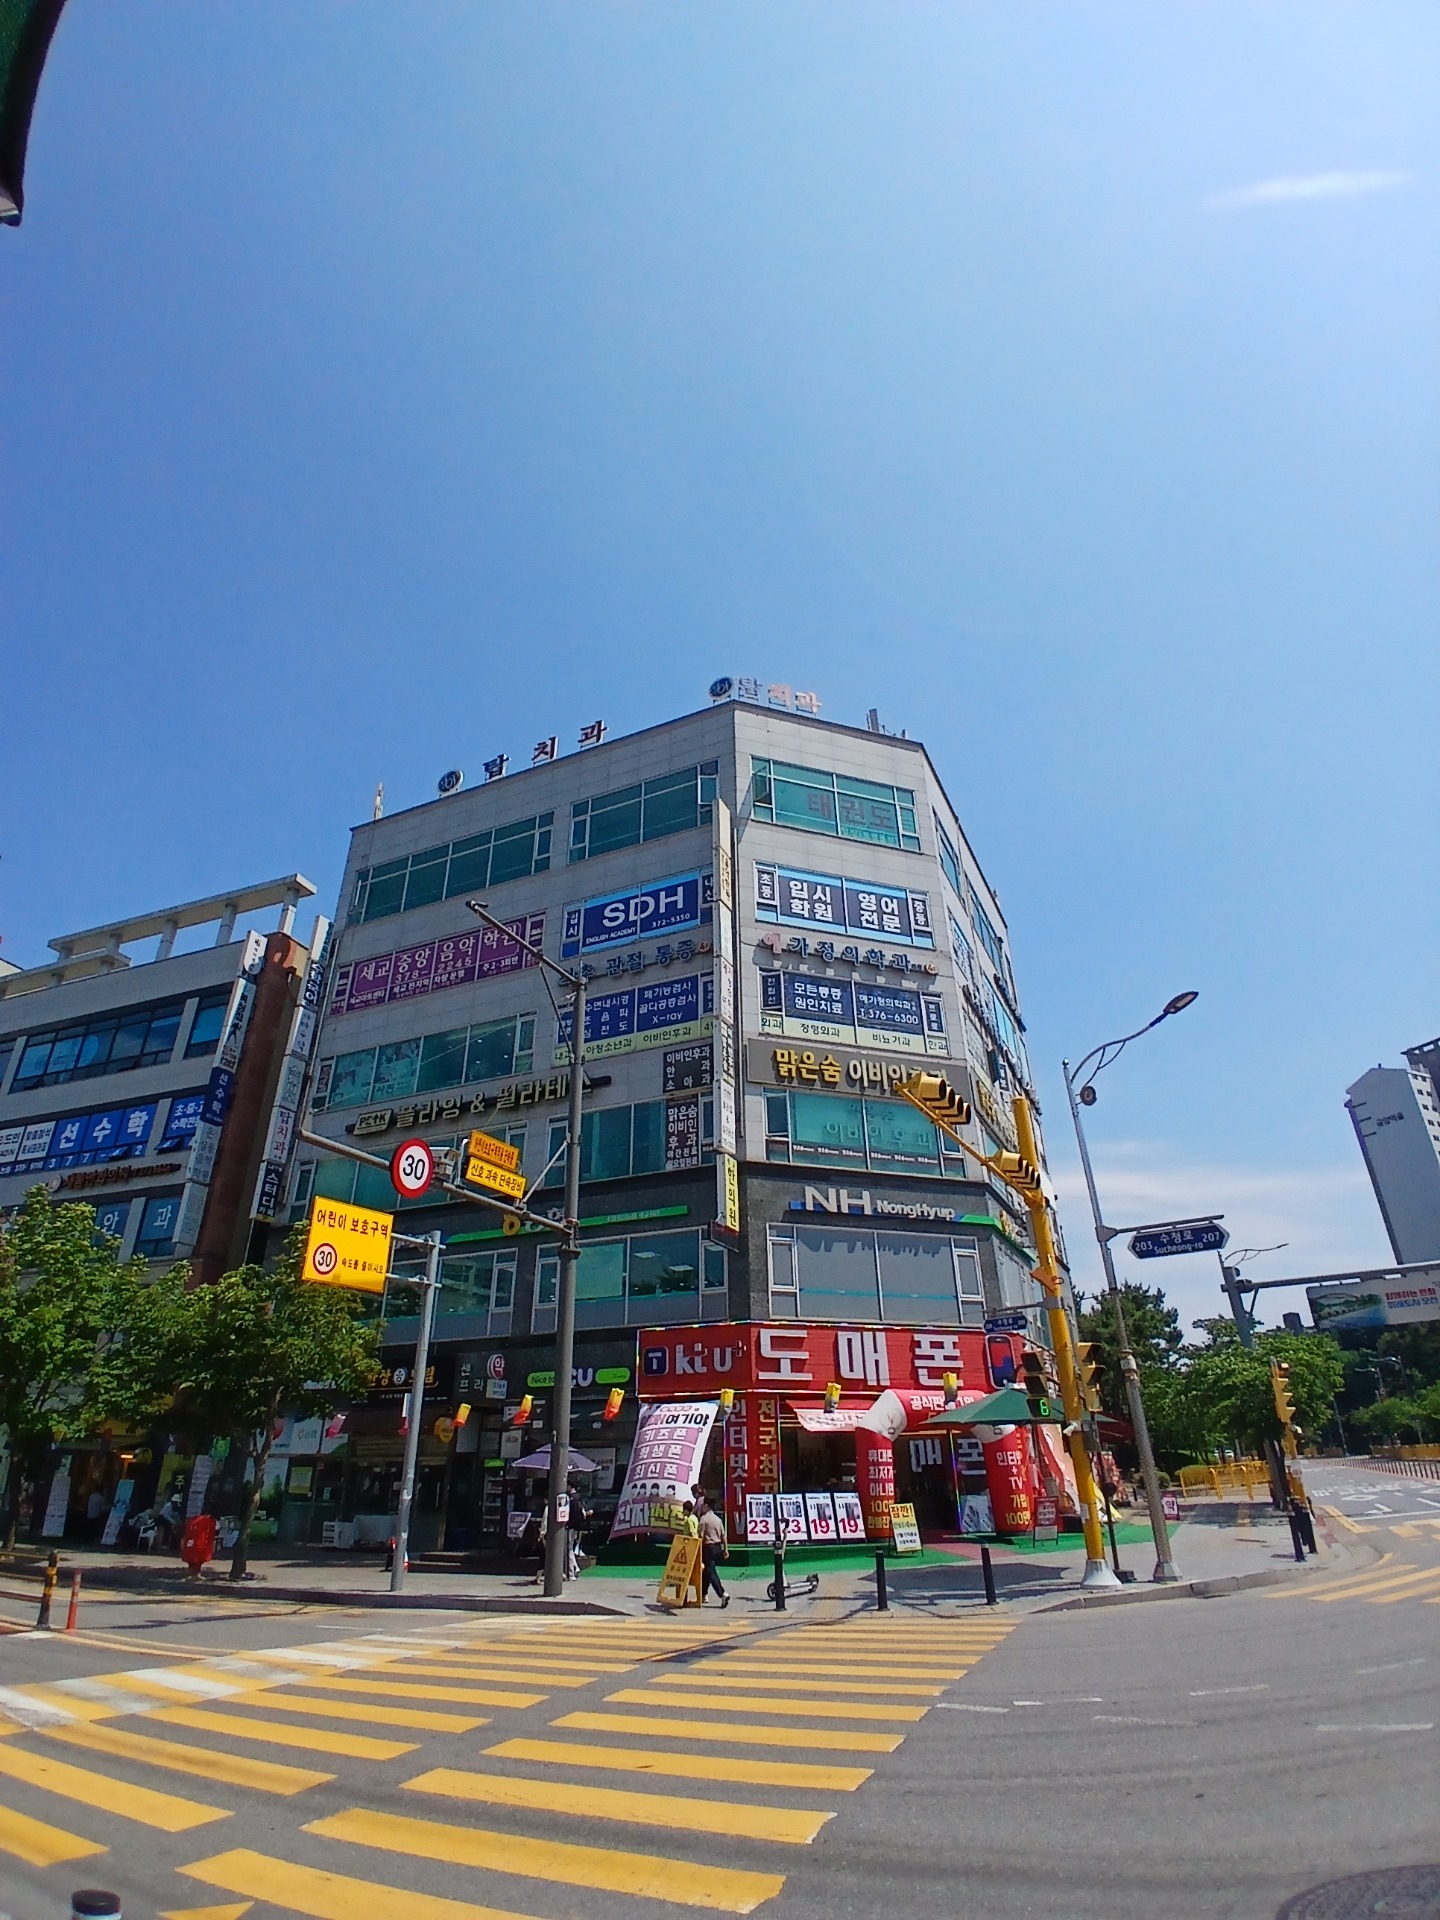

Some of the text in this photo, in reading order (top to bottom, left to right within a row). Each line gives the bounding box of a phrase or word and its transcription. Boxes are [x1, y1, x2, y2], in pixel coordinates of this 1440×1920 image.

[602, 886, 684, 928] SDH
[858, 892, 898, 915] 영어
[791, 898, 901, 933] 학원 전문
[586, 926, 636, 944] ENGLISH ACADEMY
[606, 951, 645, 976] 관절
[656, 939, 695, 965] 통증
[643, 981, 692, 999] 폐기능검사
[794, 982, 842, 1000] 모든통증
[585, 995, 629, 1012] 수면내시경
[639, 993, 697, 1014] 골다공증검사
[795, 997, 843, 1015] 원인치료
[652, 1011, 683, 1025] X-ray
[761, 1017, 782, 1030] 외과
[643, 1026, 692, 1043] 이비인후과
[800, 1023, 840, 1037] 정형외과
[582, 1038, 632, 1056] 아청소년과
[872, 1033, 911, 1047] 비뇨기과
[666, 1047, 710, 1063] 이비인후과
[775, 1049, 841, 1083] 맑은숨
[397, 1095, 462, 1129] 플라잉
[470, 1092, 485, 1113] &
[668, 1104, 698, 1122] 맑은숨
[274, 1111, 291, 1155] 탑치과
[668, 1118, 698, 1136] 이비인
[402, 1154, 425, 1181] 30
[471, 1163, 523, 1192] 신호 과속 단속장비
[804, 1186, 956, 1220] NH NongHyup
[317, 1209, 388, 1239] 어린이 보호구역
[1135, 1232, 1220, 1254] 203 Sucheong-ro 207
[1160, 1230, 1194, 1243] 수청로
[318, 1251, 333, 1268] 30
[494, 1358, 505, 1375] 약
[675, 1343, 708, 1375] kt
[758, 1328, 964, 1387] 도매폰
[644, 1428, 687, 1441] 키즈폰
[1009, 1476, 1023, 1491] TV
[890, 1505, 913, 1519] 잠깐!
[748, 1519, 770, 1535] 23
[810, 1519, 831, 1535] 19
[838, 1518, 859, 1534] 19
